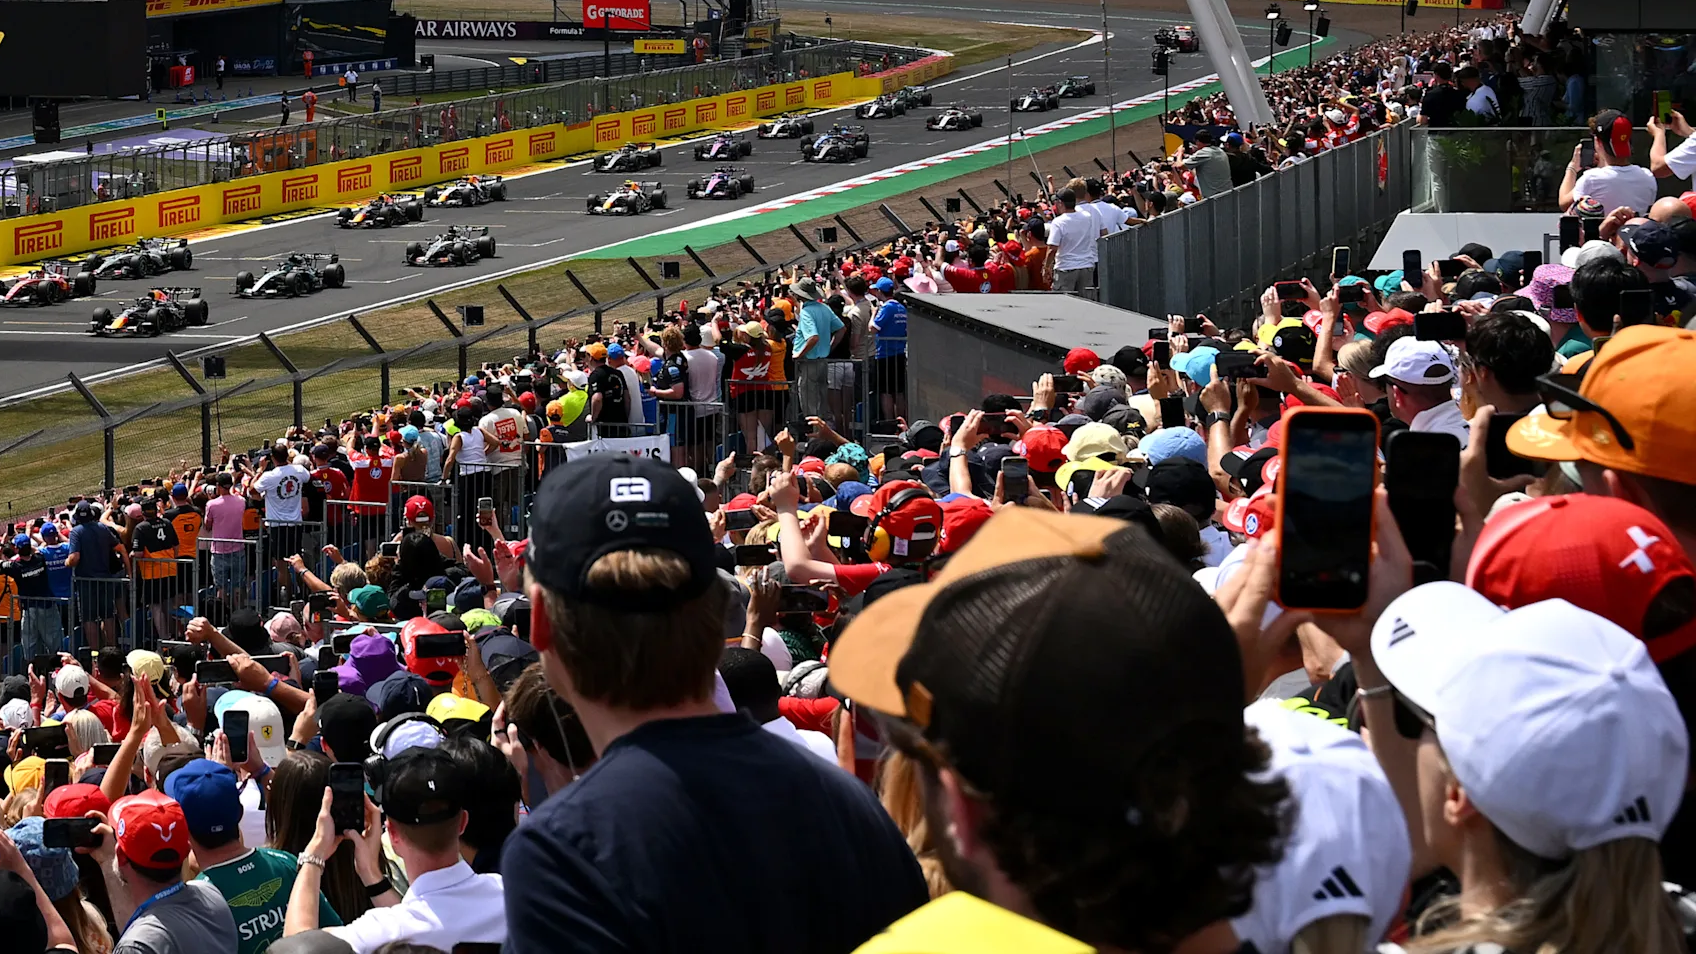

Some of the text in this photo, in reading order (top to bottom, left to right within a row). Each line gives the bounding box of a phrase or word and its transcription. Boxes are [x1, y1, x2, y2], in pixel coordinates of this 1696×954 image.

[442, 20, 517, 39] AIRWAYS
[550, 27, 579, 36] Formula
[644, 42, 675, 50] PIRELLI
[757, 91, 776, 110] PIRELLI
[786, 86, 804, 104] PIRELLI
[815, 81, 832, 99] PIRELLI
[695, 103, 717, 123] PIRELLI
[726, 97, 747, 117] PIRELLI
[632, 114, 656, 136] PIRELLI
[664, 108, 686, 130] PIRELLI
[596, 119, 621, 143] PIRELLI
[485, 139, 514, 165] PIRELLI
[529, 131, 556, 156] PIRELLI
[390, 156, 422, 183] PIRELLI
[439, 148, 469, 174] PIRELLI
[282, 174, 318, 204] PIRELLI
[338, 165, 371, 193] PIRELLI
[223, 184, 261, 215] PIRELLI
[159, 195, 201, 228] PIRELLI
[89, 207, 134, 241] PIRELLI
[14, 220, 63, 255] PIRELLI
[498, 425, 516, 435] 1976
[157, 528, 166, 541] 4
[238, 862, 255, 874] BOSS
[238, 906, 290, 941] STROL
